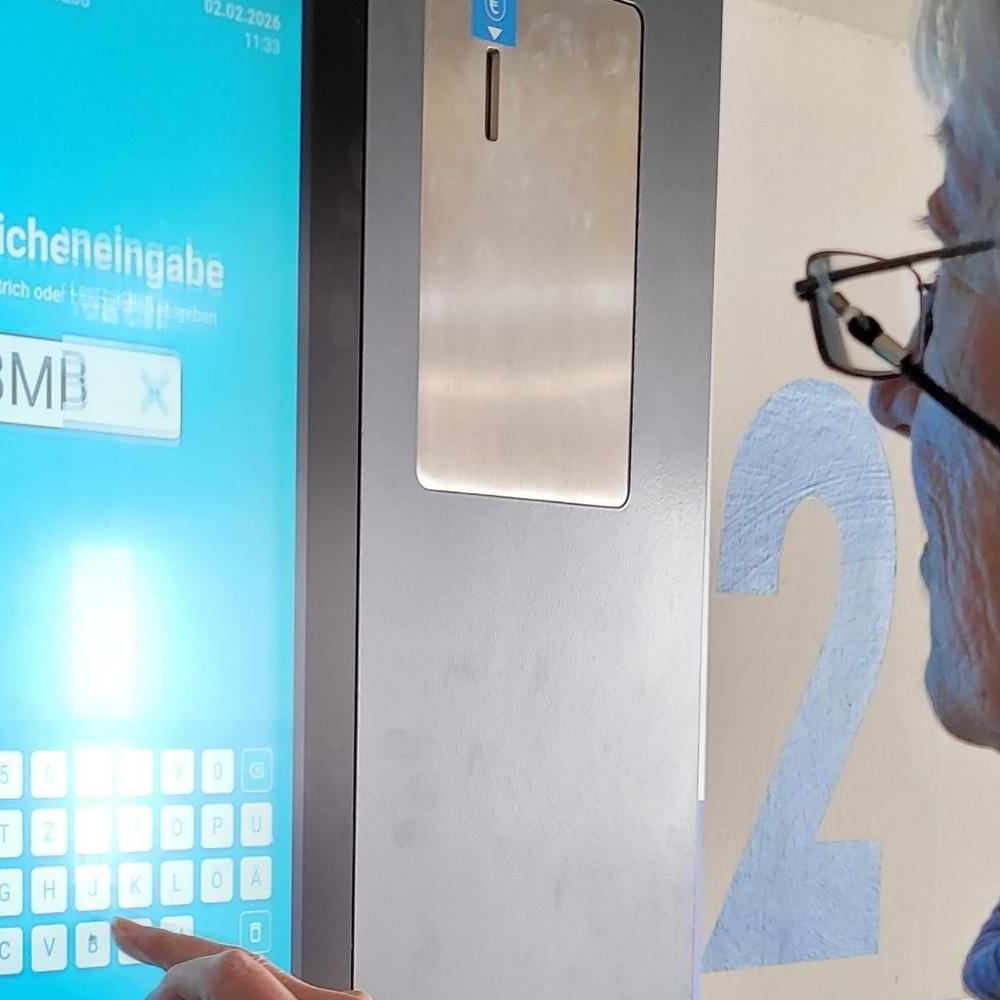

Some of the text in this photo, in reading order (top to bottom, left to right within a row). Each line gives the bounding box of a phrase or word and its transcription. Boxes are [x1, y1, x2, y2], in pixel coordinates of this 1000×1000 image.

[204, 0, 281, 31] 02.02.2026
[244, 31, 281, 55] 11:33
[33, 284, 66, 303] oder
[700, 378, 897, 972] 2
[0, 765, 9, 784] 5
[0, 824, 10, 844] T
[44, 822, 56, 841] Z
[212, 816, 223, 835] P
[0, 882, 11, 902] G
[44, 879, 56, 899] H
[88, 877, 98, 896] J
[131, 875, 142, 894] K
[173, 873, 182, 892] L
[44, 937, 56, 956] V
